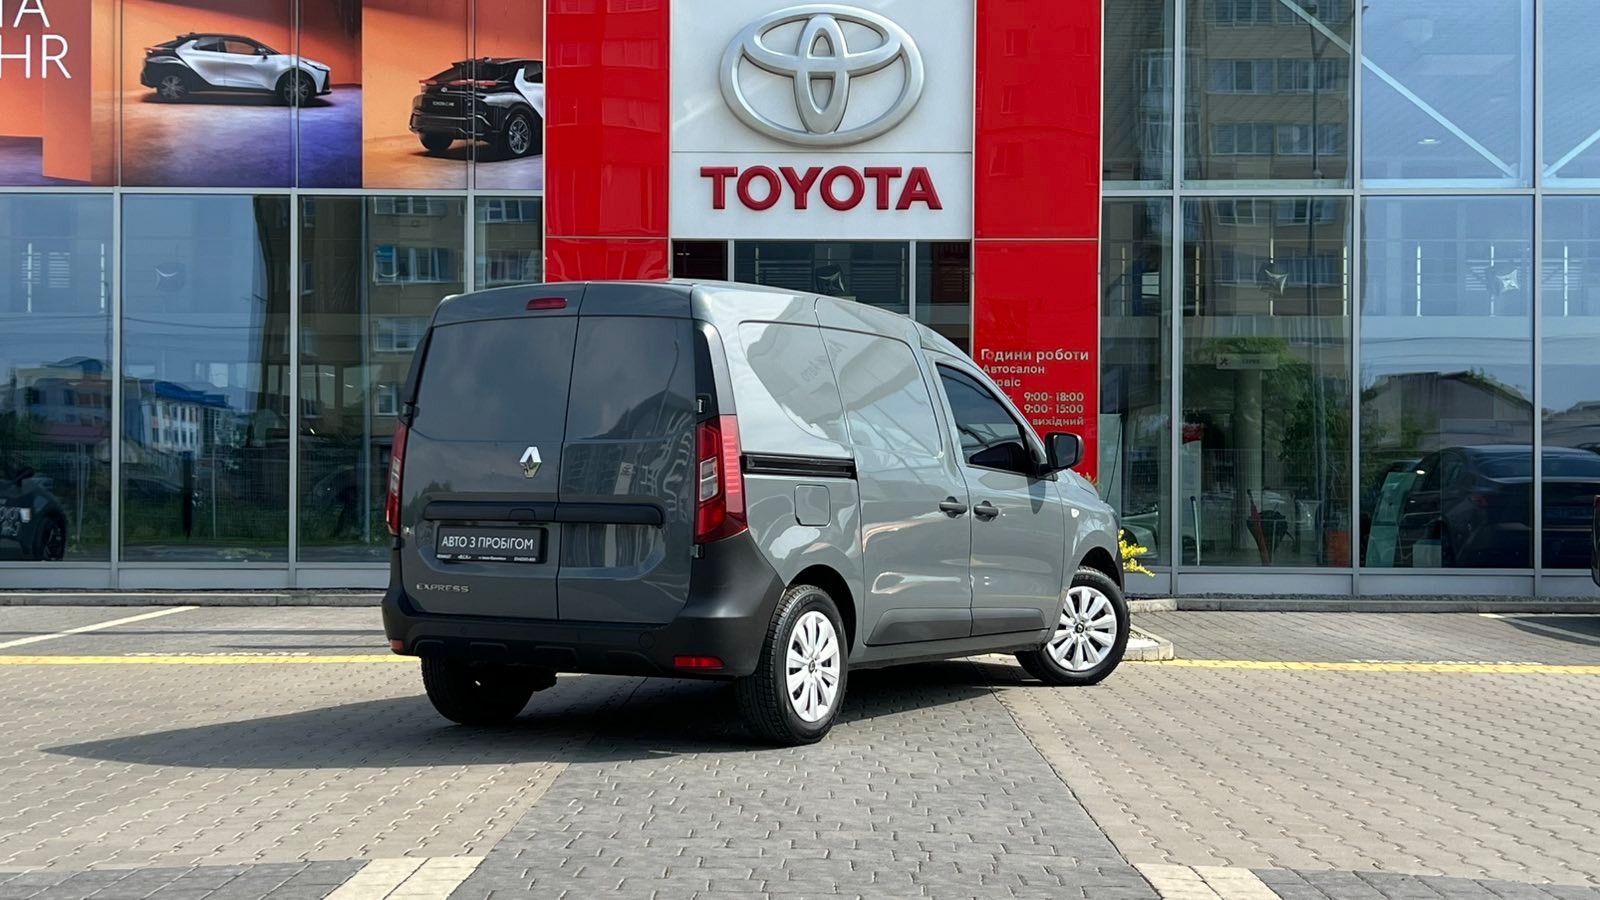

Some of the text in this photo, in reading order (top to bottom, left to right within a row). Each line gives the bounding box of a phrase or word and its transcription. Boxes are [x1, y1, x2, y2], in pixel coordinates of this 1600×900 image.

[700, 165, 943, 211] TOYOTA
[981, 348, 1089, 363] Години роботи
[983, 364, 1045, 374] Автосалон
[1032, 416, 1084, 427] вихідний
[441, 536, 468, 548] АВТО
[478, 537, 534, 550] ПРОБІГОМ
[416, 582, 469, 593] EXPRESS
